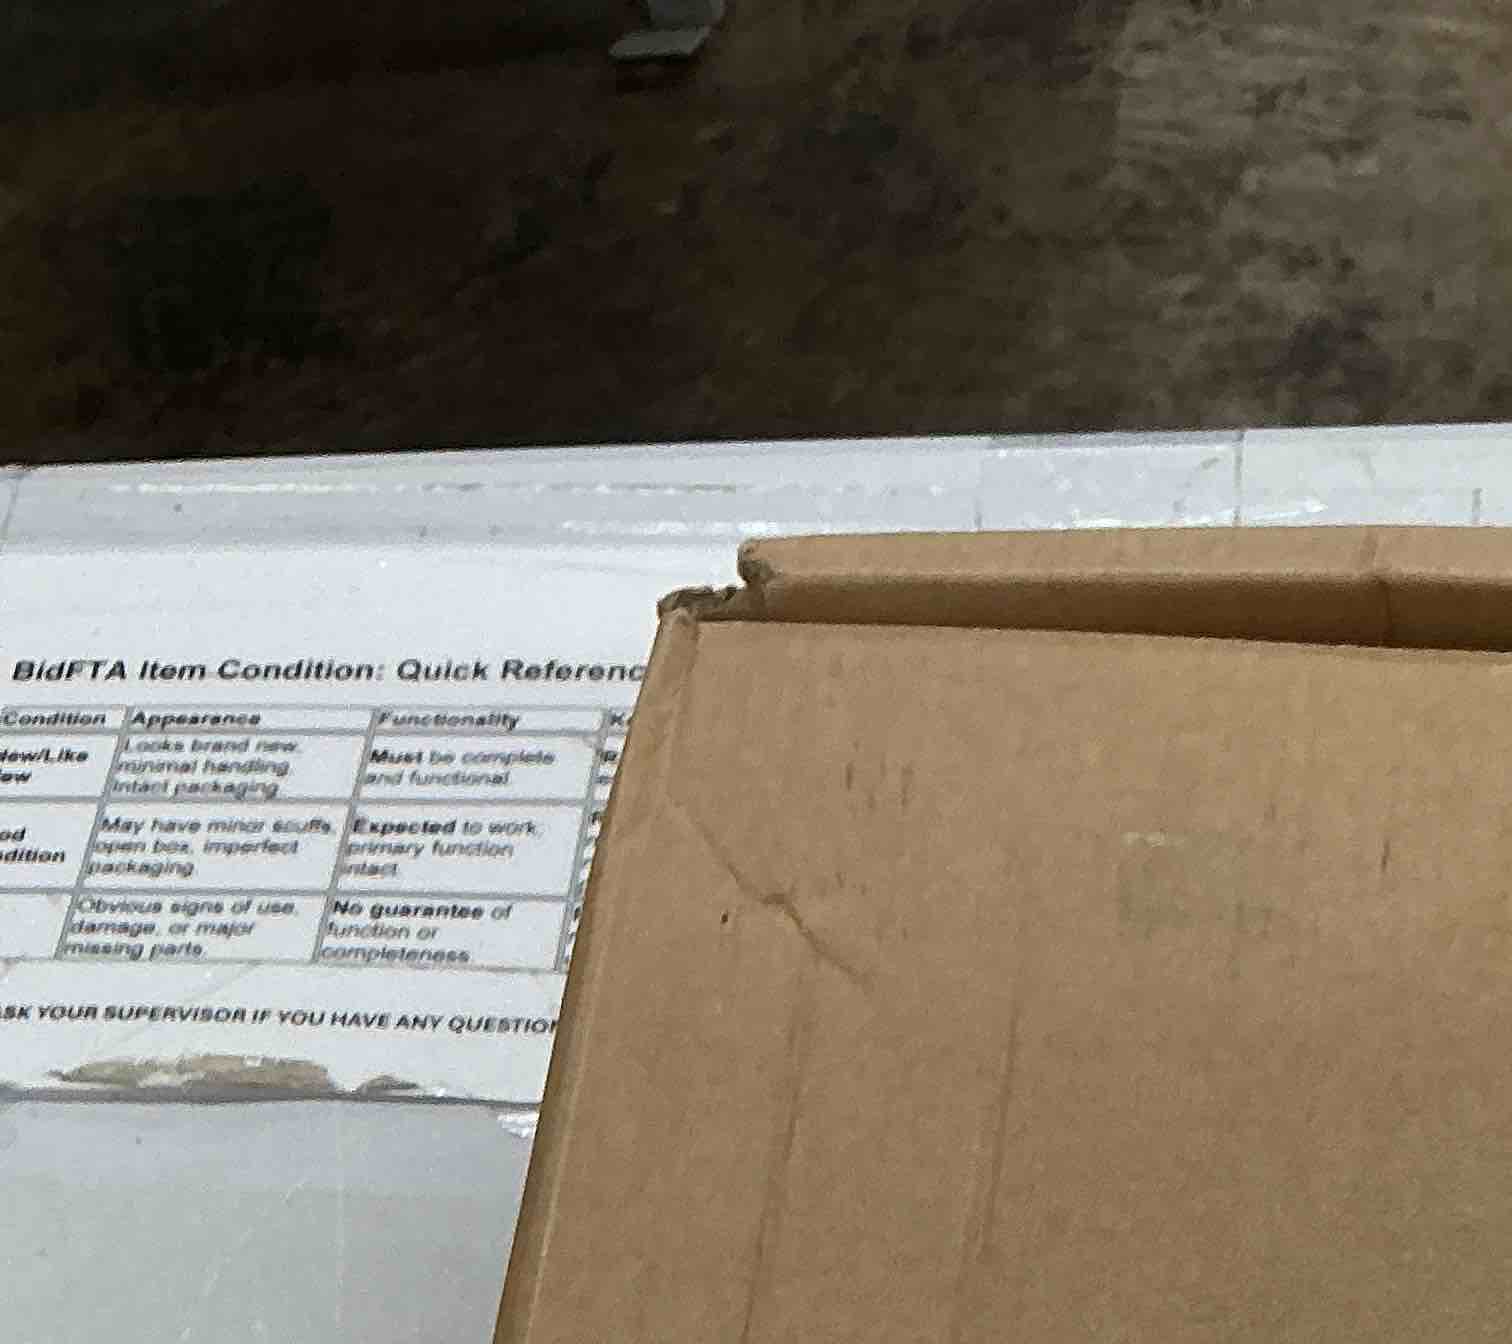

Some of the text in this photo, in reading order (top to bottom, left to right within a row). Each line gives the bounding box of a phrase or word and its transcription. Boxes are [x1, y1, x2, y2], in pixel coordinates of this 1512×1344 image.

[11, 658, 646, 682] BidFTA Item Condition: Quick Referenc
[131, 711, 262, 730] Appearance
[378, 711, 519, 730] Functionality
[125, 739, 184, 752] Looks
[191, 738, 249, 752] brand
[118, 759, 197, 774] minimal
[369, 748, 556, 767] Must be complete
[365, 770, 403, 786] and
[101, 817, 144, 835] May
[151, 817, 201, 833] have
[207, 818, 264, 833] minor
[353, 817, 456, 836] Expected
[463, 819, 482, 835] to
[95, 841, 146, 858] open
[203, 839, 299, 857] imperfect
[345, 841, 514, 859] primary function
[77, 895, 162, 913] Obvious
[170, 896, 224, 916] signs
[230, 896, 252, 913] of
[333, 900, 513, 921] No guarantee of
[168, 921, 189, 935] or
[195, 919, 256, 939] major
[326, 922, 440, 941] function or
[63, 940, 144, 960] missing
[38, 1004, 97, 1021] YOUR
[103, 1004, 249, 1024] SUPERVISOR
[251, 1006, 272, 1024] IF
[276, 1008, 326, 1027] YOU
[330, 1010, 390, 1029] HAVE
[393, 1012, 443, 1031] ANY
